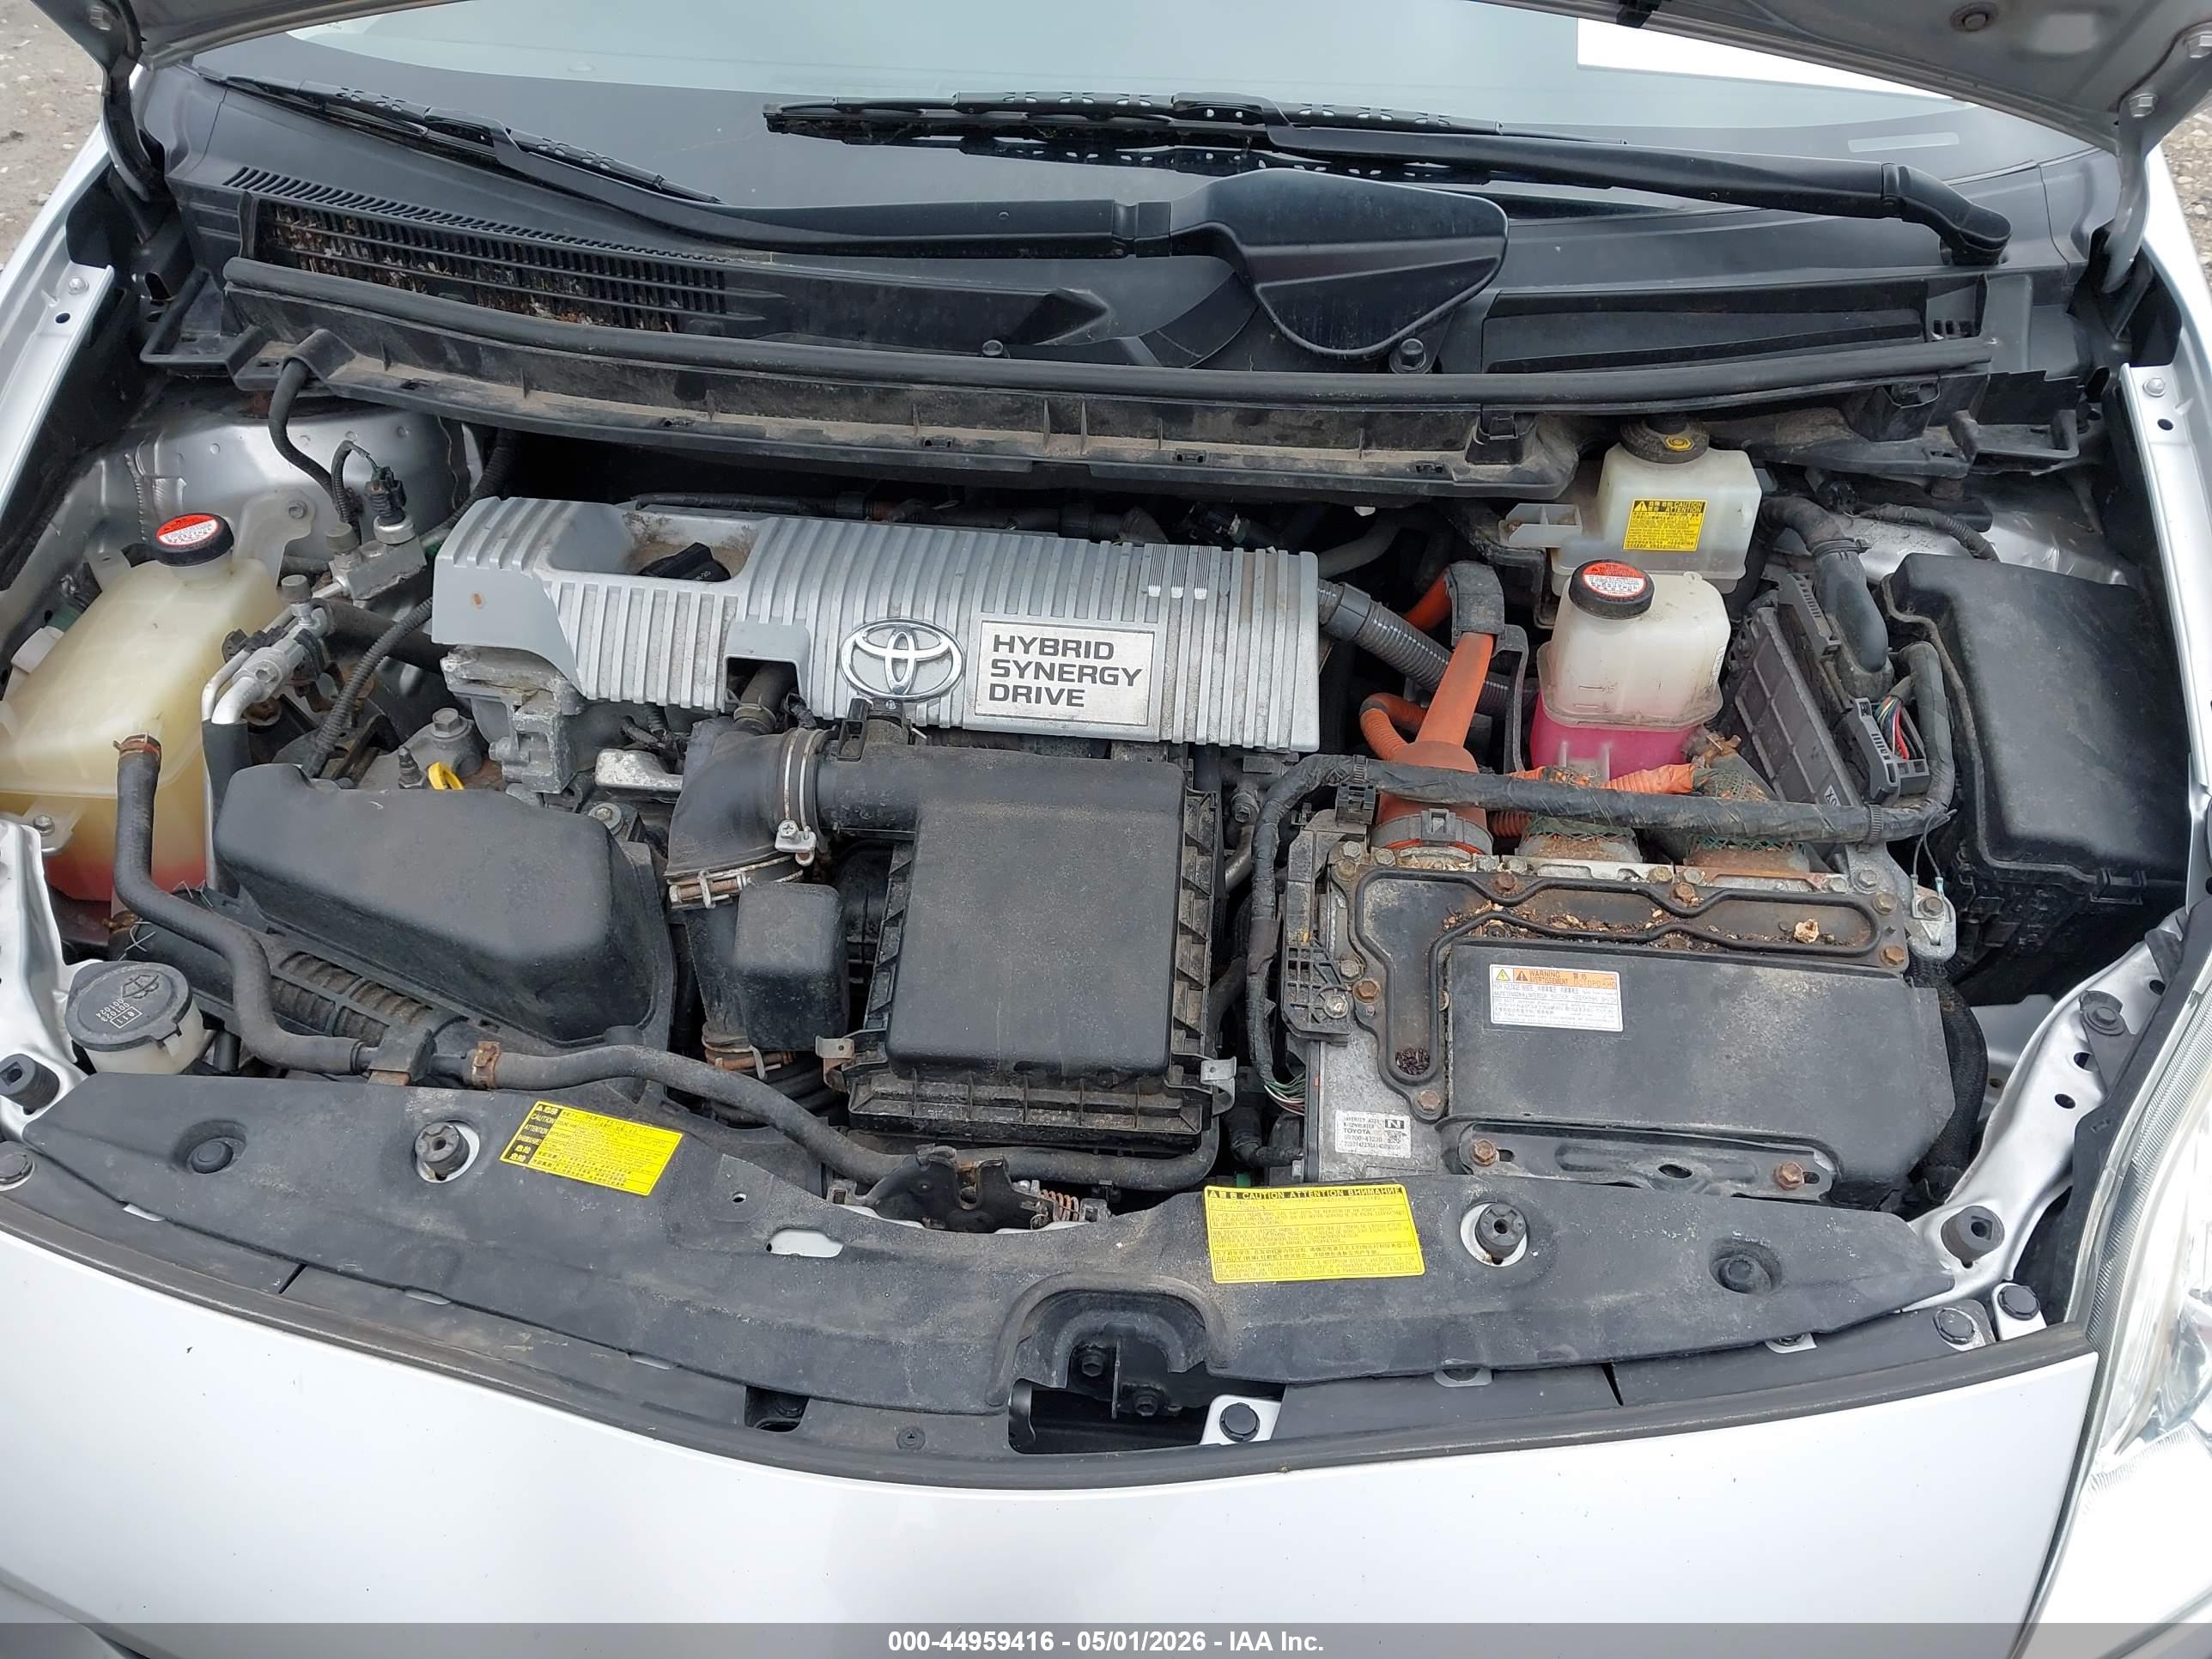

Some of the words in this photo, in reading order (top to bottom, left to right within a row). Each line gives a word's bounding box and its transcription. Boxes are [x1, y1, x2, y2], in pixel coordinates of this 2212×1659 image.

[993, 635, 1115, 660] HYBRID
[990, 659, 1142, 686] SYNERGY
[988, 684, 1085, 708] DRIVE
[1529, 969, 1560, 978] WARNING
[1529, 976, 1568, 985] AVERTISSEMENT
[531, 1113, 556, 1124] CAUTION
[524, 1124, 550, 1134] ATTENTION
[1290, 1189, 1344, 1200] ATTENTION
[1348, 1187, 1401, 1196] ВНИМАНИЕ
